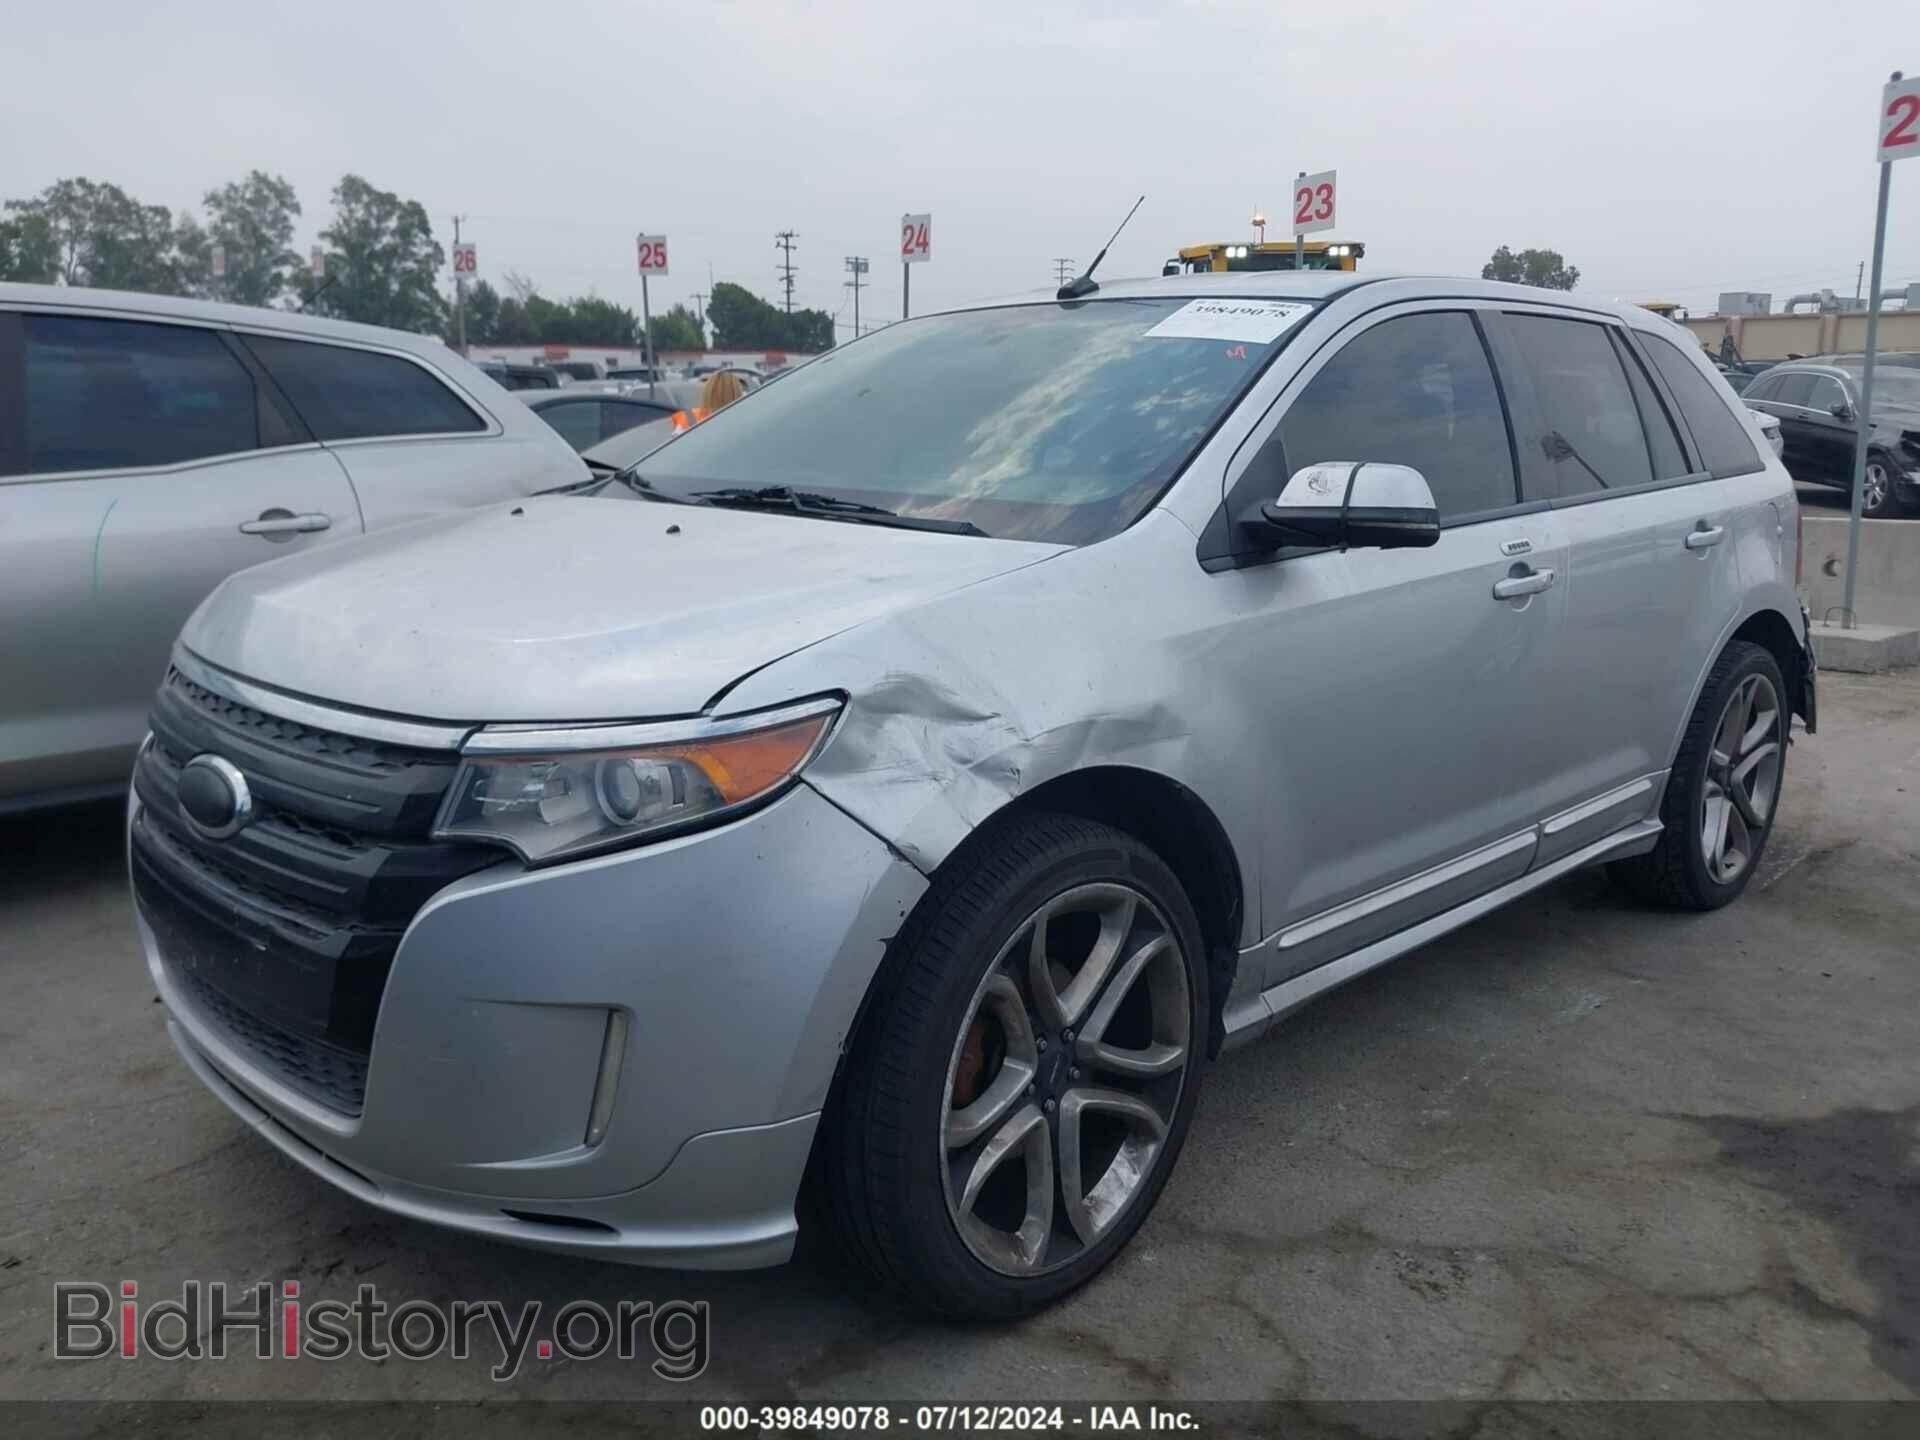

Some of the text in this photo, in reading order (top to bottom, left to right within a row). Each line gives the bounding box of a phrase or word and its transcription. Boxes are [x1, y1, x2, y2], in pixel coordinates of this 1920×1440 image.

[1296, 183, 1333, 224] 23
[902, 224, 929, 255] 24
[454, 250, 476, 272] 26
[639, 243, 667, 268] 25
